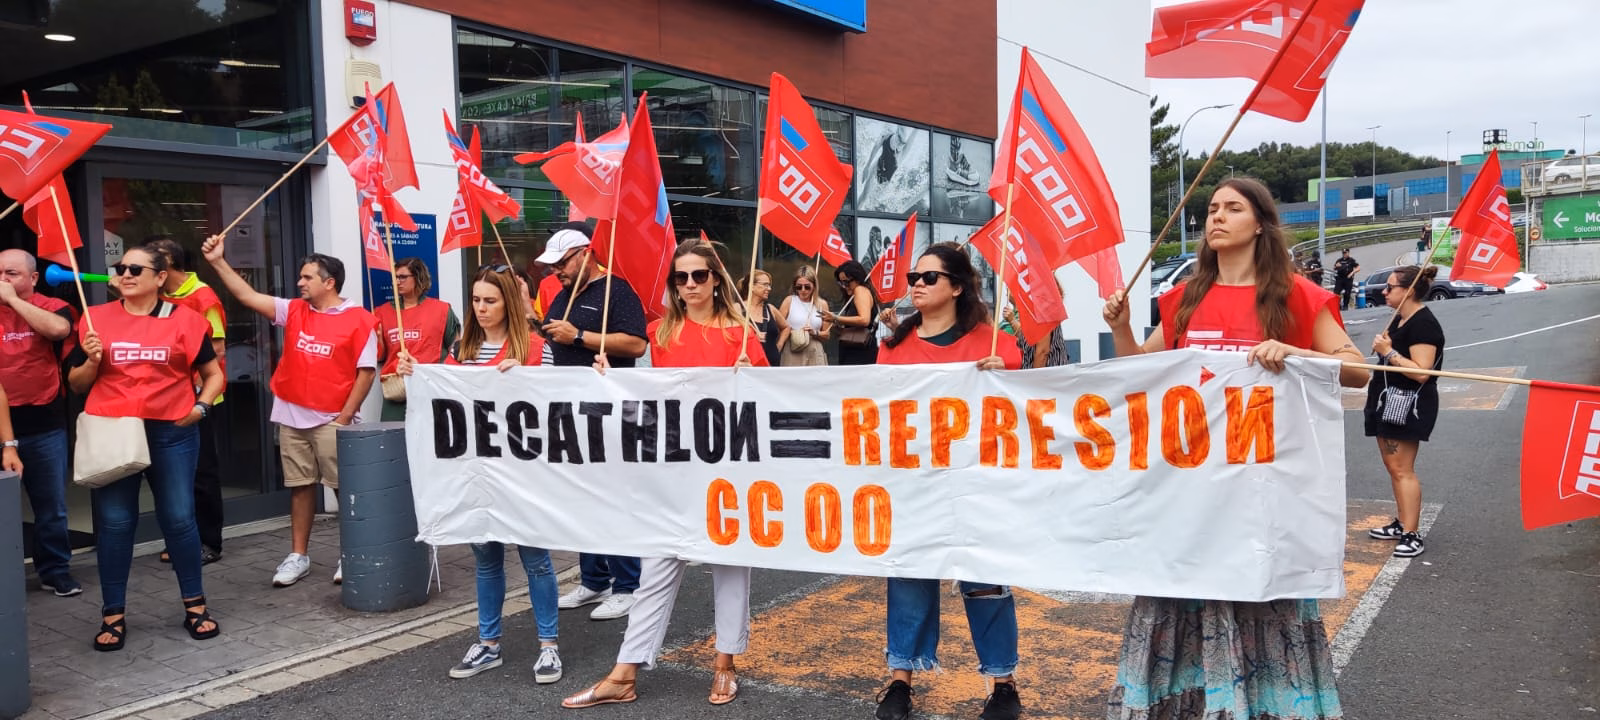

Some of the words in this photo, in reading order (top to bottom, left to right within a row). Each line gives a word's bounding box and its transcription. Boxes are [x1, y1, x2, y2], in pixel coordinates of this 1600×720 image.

[297, 338, 331, 355] CCOO
[114, 350, 166, 361] CCOO
[432, 397, 760, 464] DECATHLON
